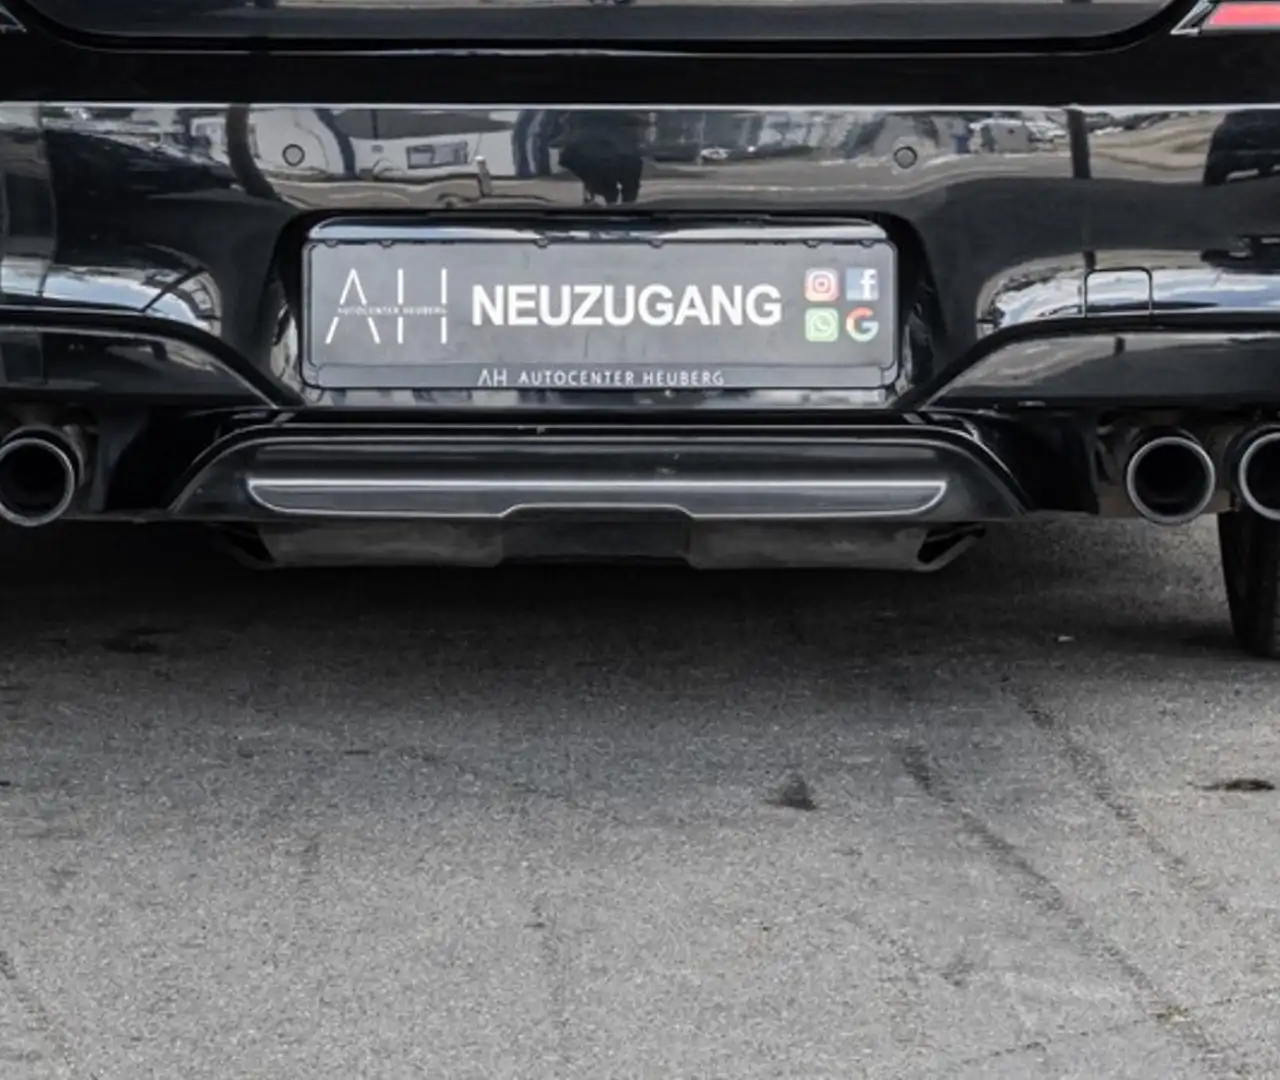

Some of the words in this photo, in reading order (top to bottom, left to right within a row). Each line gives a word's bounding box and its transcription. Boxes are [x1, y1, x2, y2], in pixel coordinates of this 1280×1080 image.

[325, 267, 447, 344] AH
[471, 284, 782, 326] NEUZUGANG
[477, 368, 507, 388] AH
[519, 369, 635, 387] AUTOCENTER
[642, 369, 724, 387] HEUBERG
